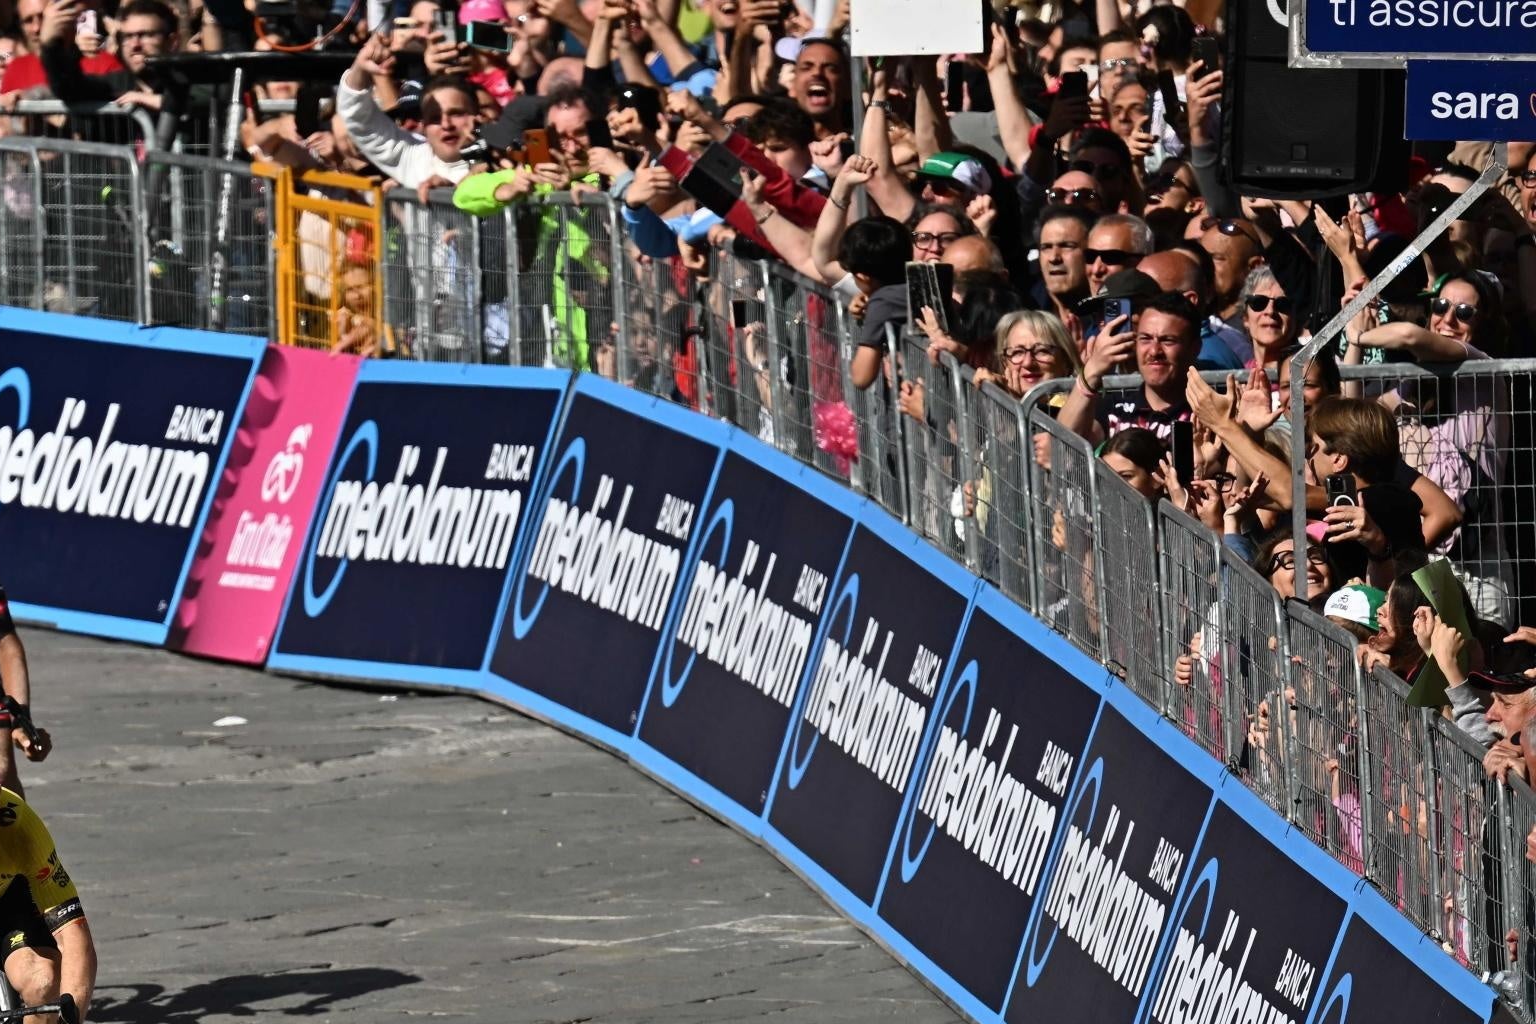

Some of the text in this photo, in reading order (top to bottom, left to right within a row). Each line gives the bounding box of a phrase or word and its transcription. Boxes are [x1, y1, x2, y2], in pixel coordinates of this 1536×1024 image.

[1330, 0, 1355, 26] ti
[1430, 90, 1519, 120] sara
[165, 404, 225, 446] BANCA
[484, 442, 536, 481] BANCA
[316, 444, 522, 570] mediolanum
[655, 493, 695, 542] BANCA
[527, 475, 681, 632] mediolanum
[793, 563, 829, 615] BANCA
[676, 539, 813, 709] mediolanum
[908, 644, 942, 698] BANCA
[804, 616, 927, 795] mediolanum
[1036, 739, 1074, 797] BANCA
[917, 706, 1058, 897] mediolanum
[1148, 836, 1185, 895] BANCA
[1043, 804, 1166, 998] mediolanum
[1274, 947, 1316, 1010] BANCA
